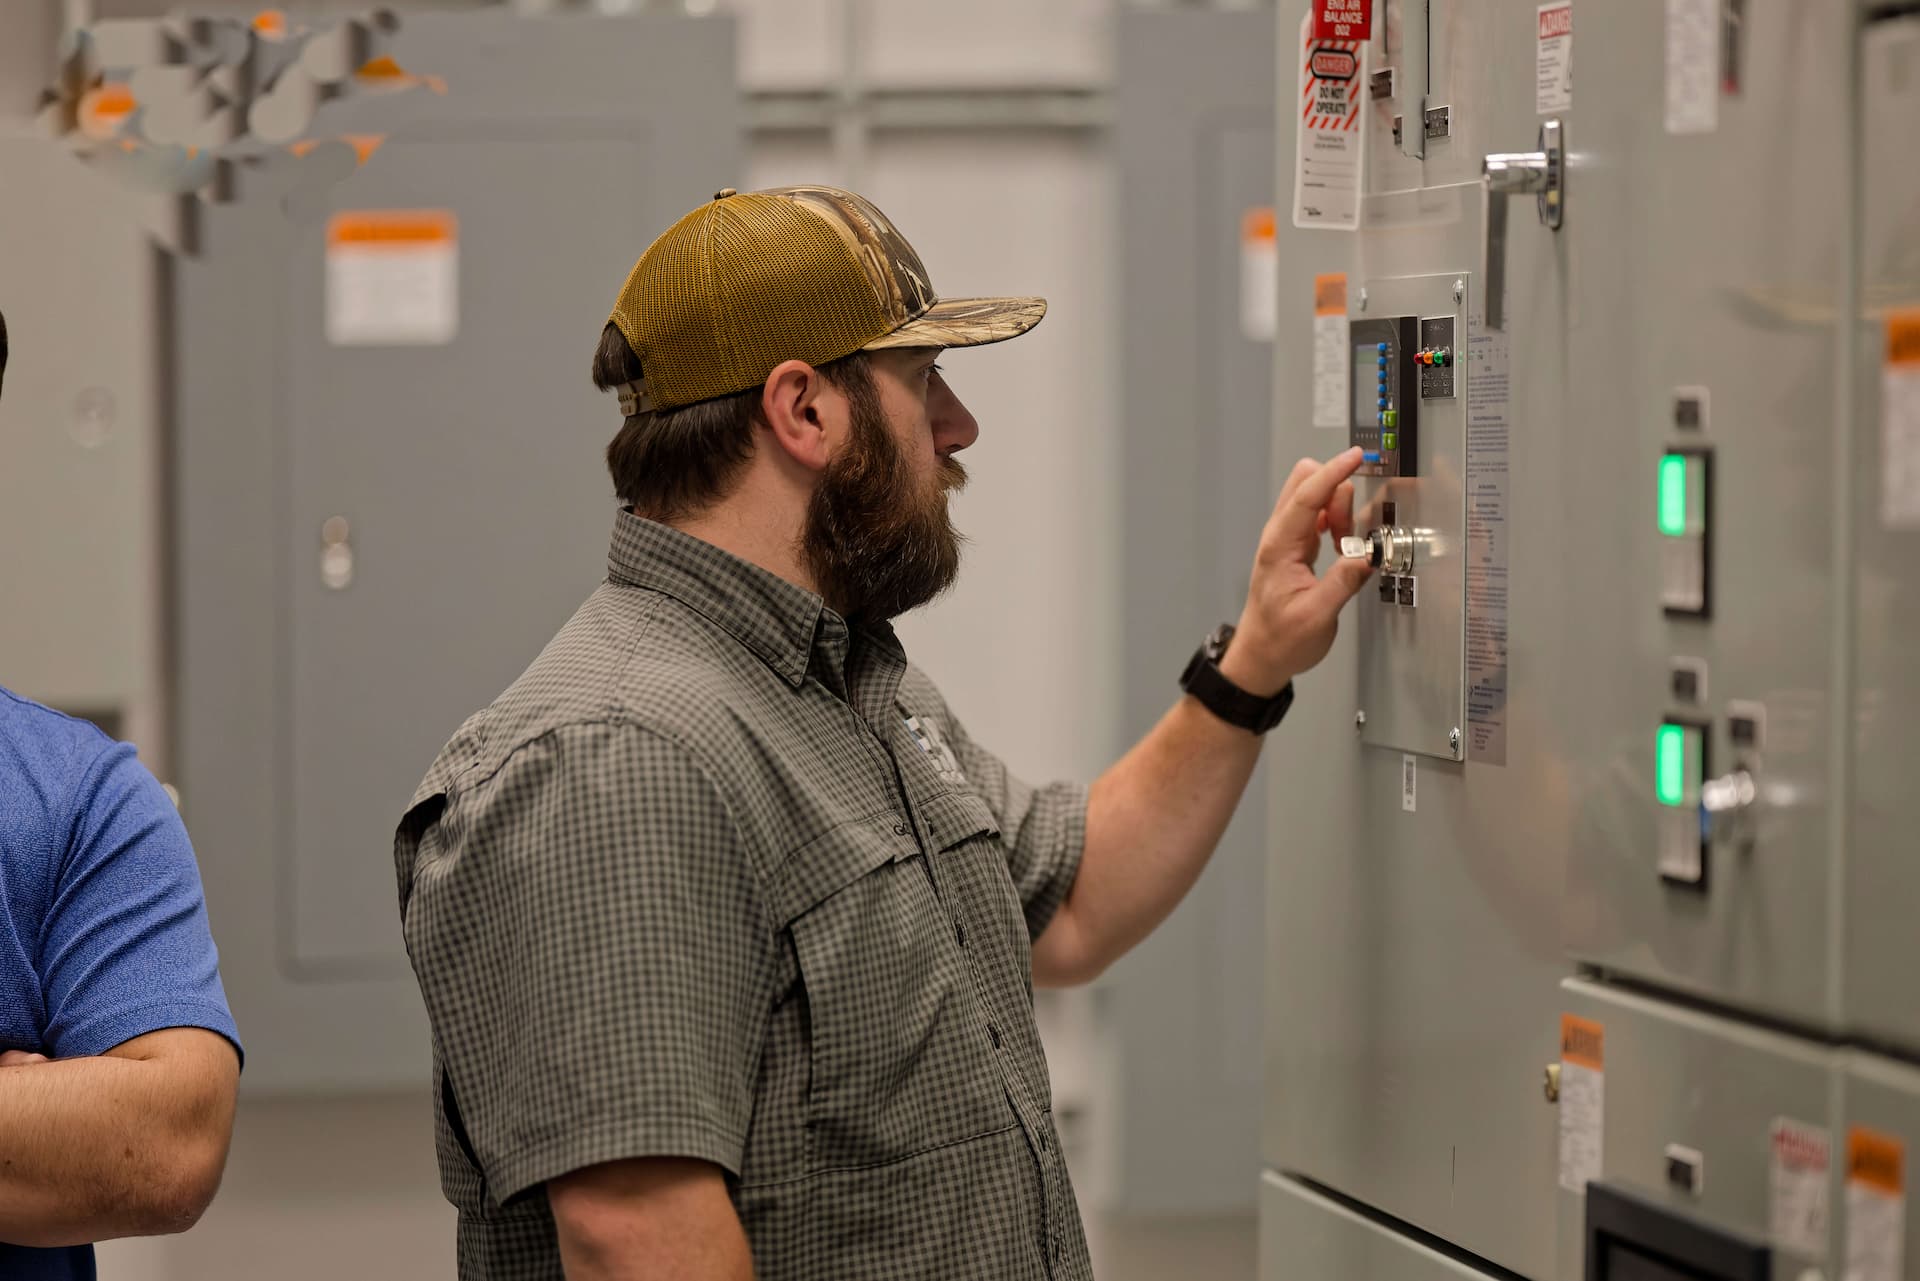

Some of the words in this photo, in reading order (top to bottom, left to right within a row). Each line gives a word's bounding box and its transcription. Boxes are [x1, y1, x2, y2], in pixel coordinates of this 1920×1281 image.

[1324, 11, 1363, 24] BALANCE
[1335, 24, 1350, 36] 002
[1320, 87, 1329, 99] DO
[1331, 88, 1344, 100] NOT
[1316, 101, 1346, 115] OPERATE
